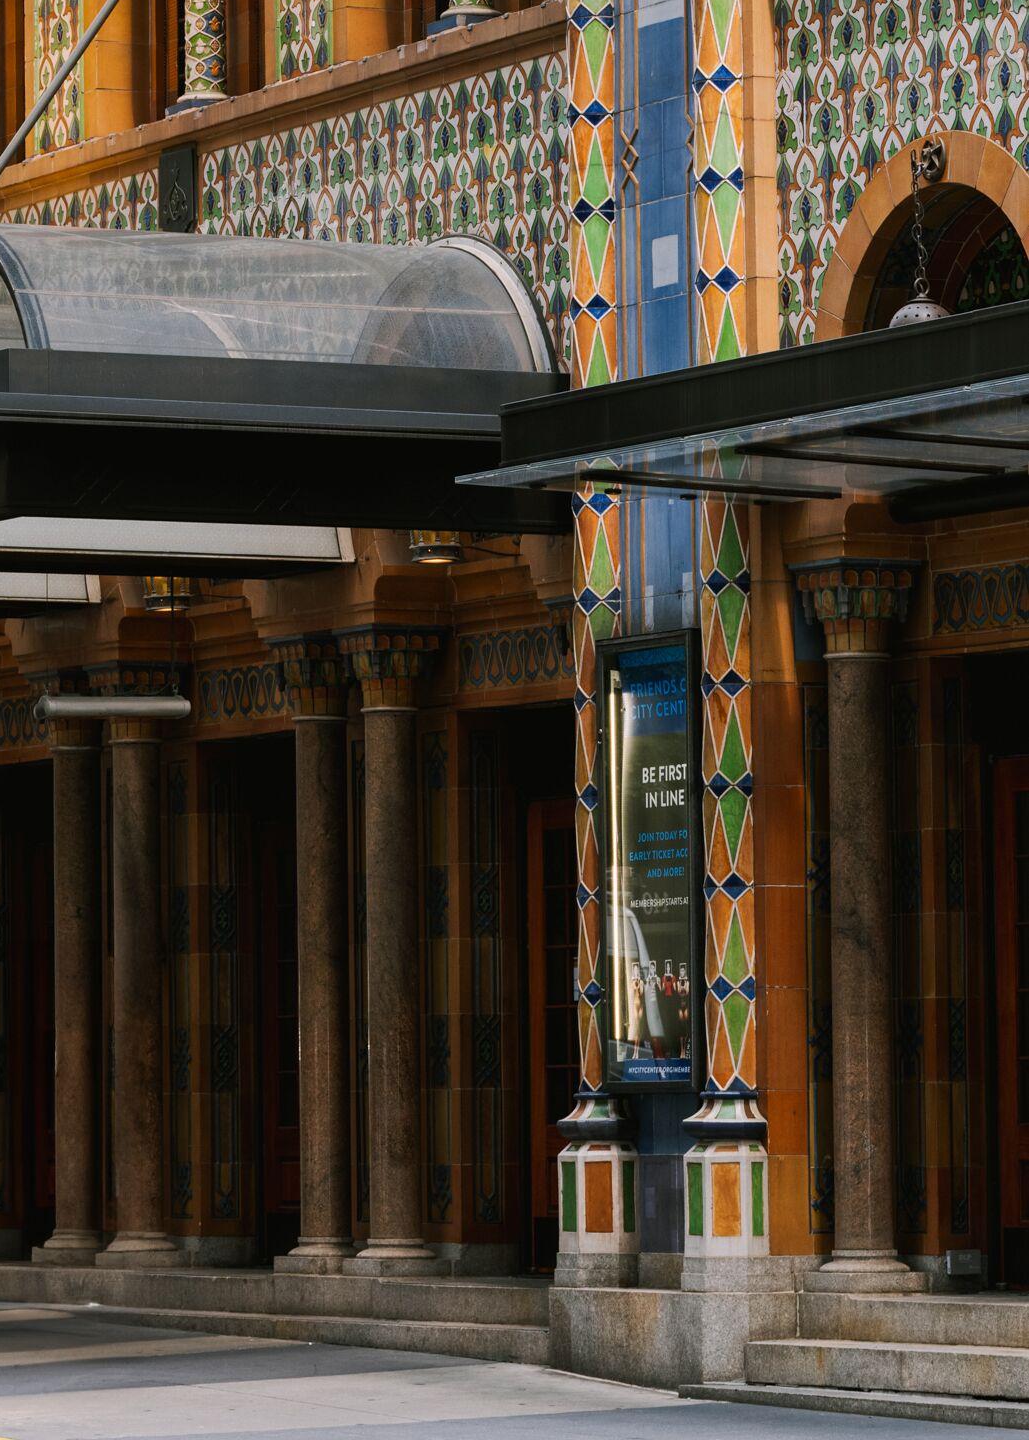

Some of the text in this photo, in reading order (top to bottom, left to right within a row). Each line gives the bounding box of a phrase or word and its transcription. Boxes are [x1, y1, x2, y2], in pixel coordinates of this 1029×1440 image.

[631, 680, 677, 698] FRIENDS
[631, 700, 687, 720] CITY CENT
[642, 763, 687, 784] BE FIRST
[645, 789, 685, 809] IN LINE
[638, 831, 654, 842] JOIN
[656, 830, 678, 841] TODAY
[629, 850, 651, 862] EARLY
[652, 849, 675, 860] TICKET
[647, 866, 685, 878] AND MORE!
[630, 899, 665, 908] MEMBERSHIP
[665, 897, 683, 906] STARTS
